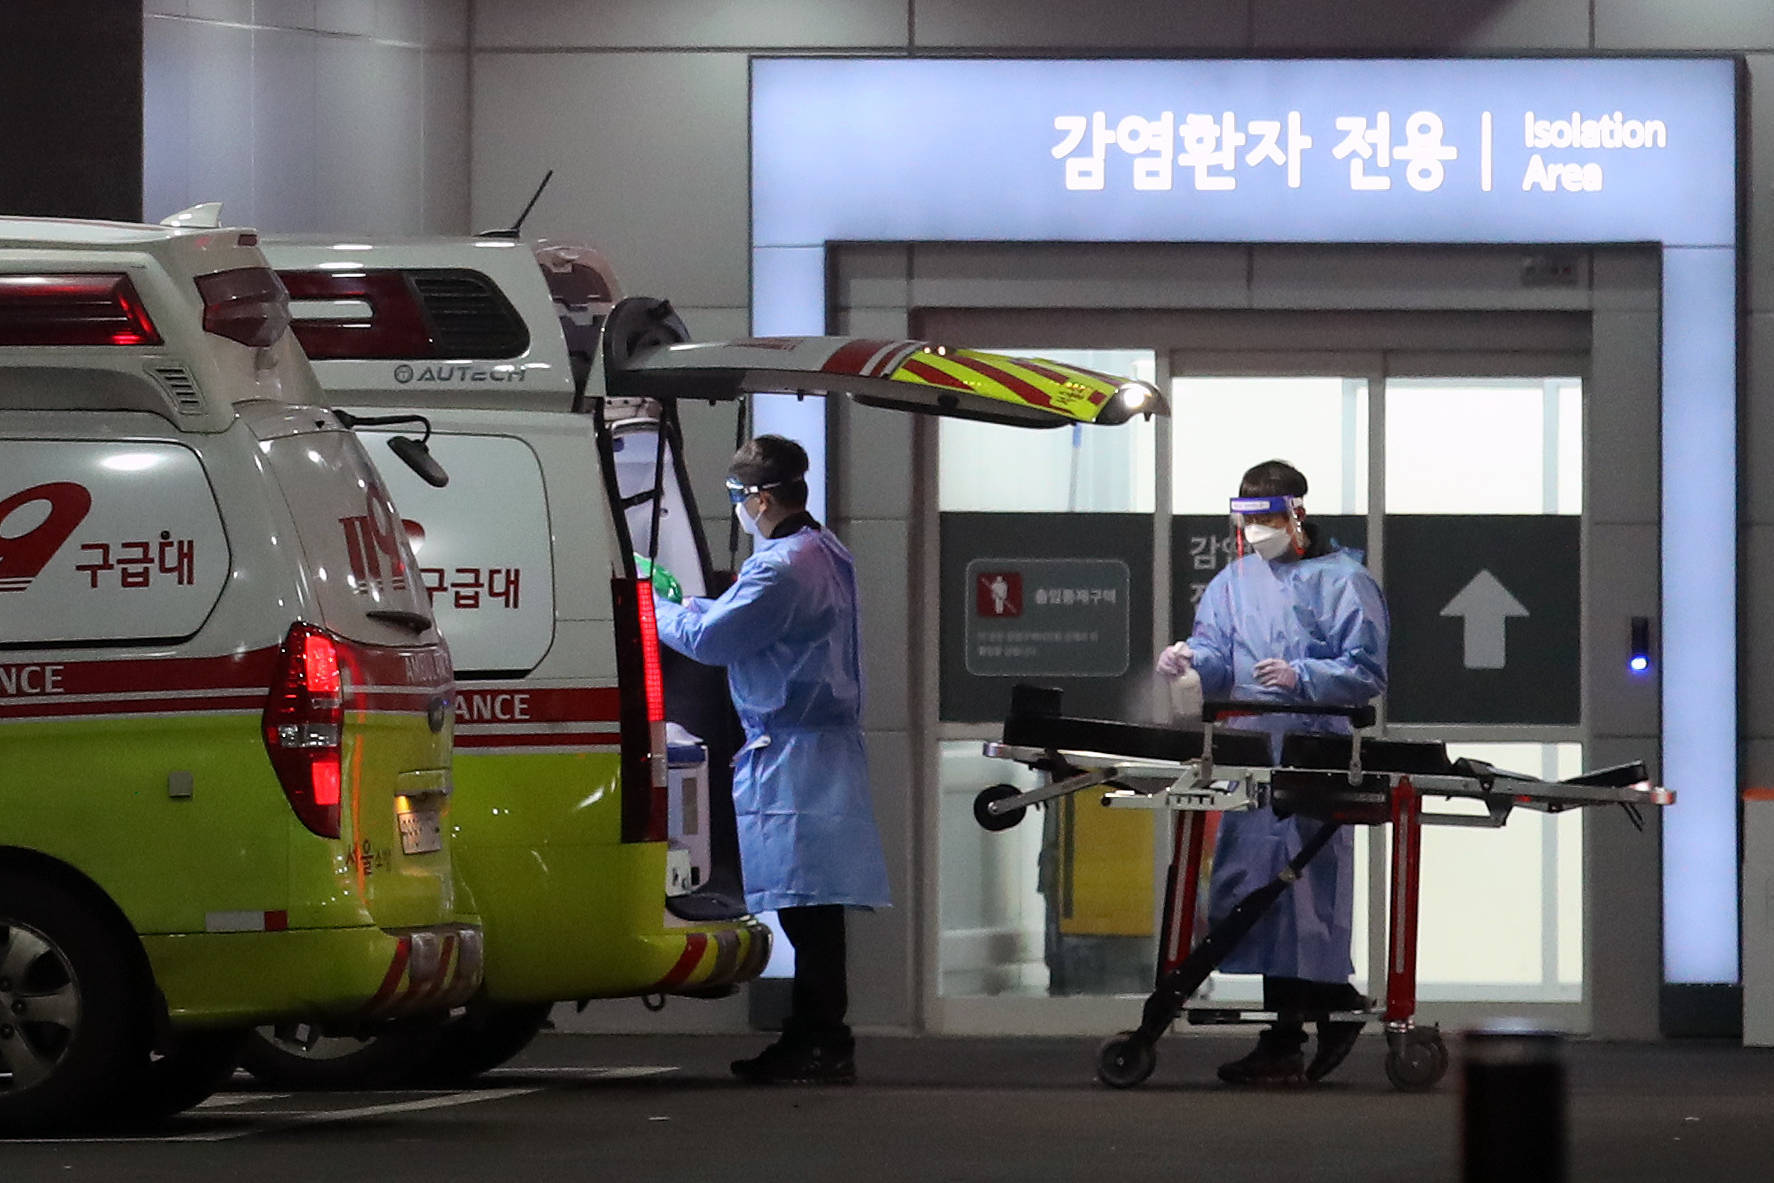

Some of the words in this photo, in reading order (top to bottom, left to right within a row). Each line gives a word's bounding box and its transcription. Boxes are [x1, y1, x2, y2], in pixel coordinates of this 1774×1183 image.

[1523, 110, 1668, 149] Isolation
[1050, 110, 1313, 191] 감염환자
[1331, 110, 1458, 192] 전용
[1521, 153, 1604, 193] Area
[417, 364, 528, 382] AUTECH
[75, 539, 194, 588] 구급대
[420, 568, 520, 609] 구급대
[454, 694, 530, 720] ANCE
